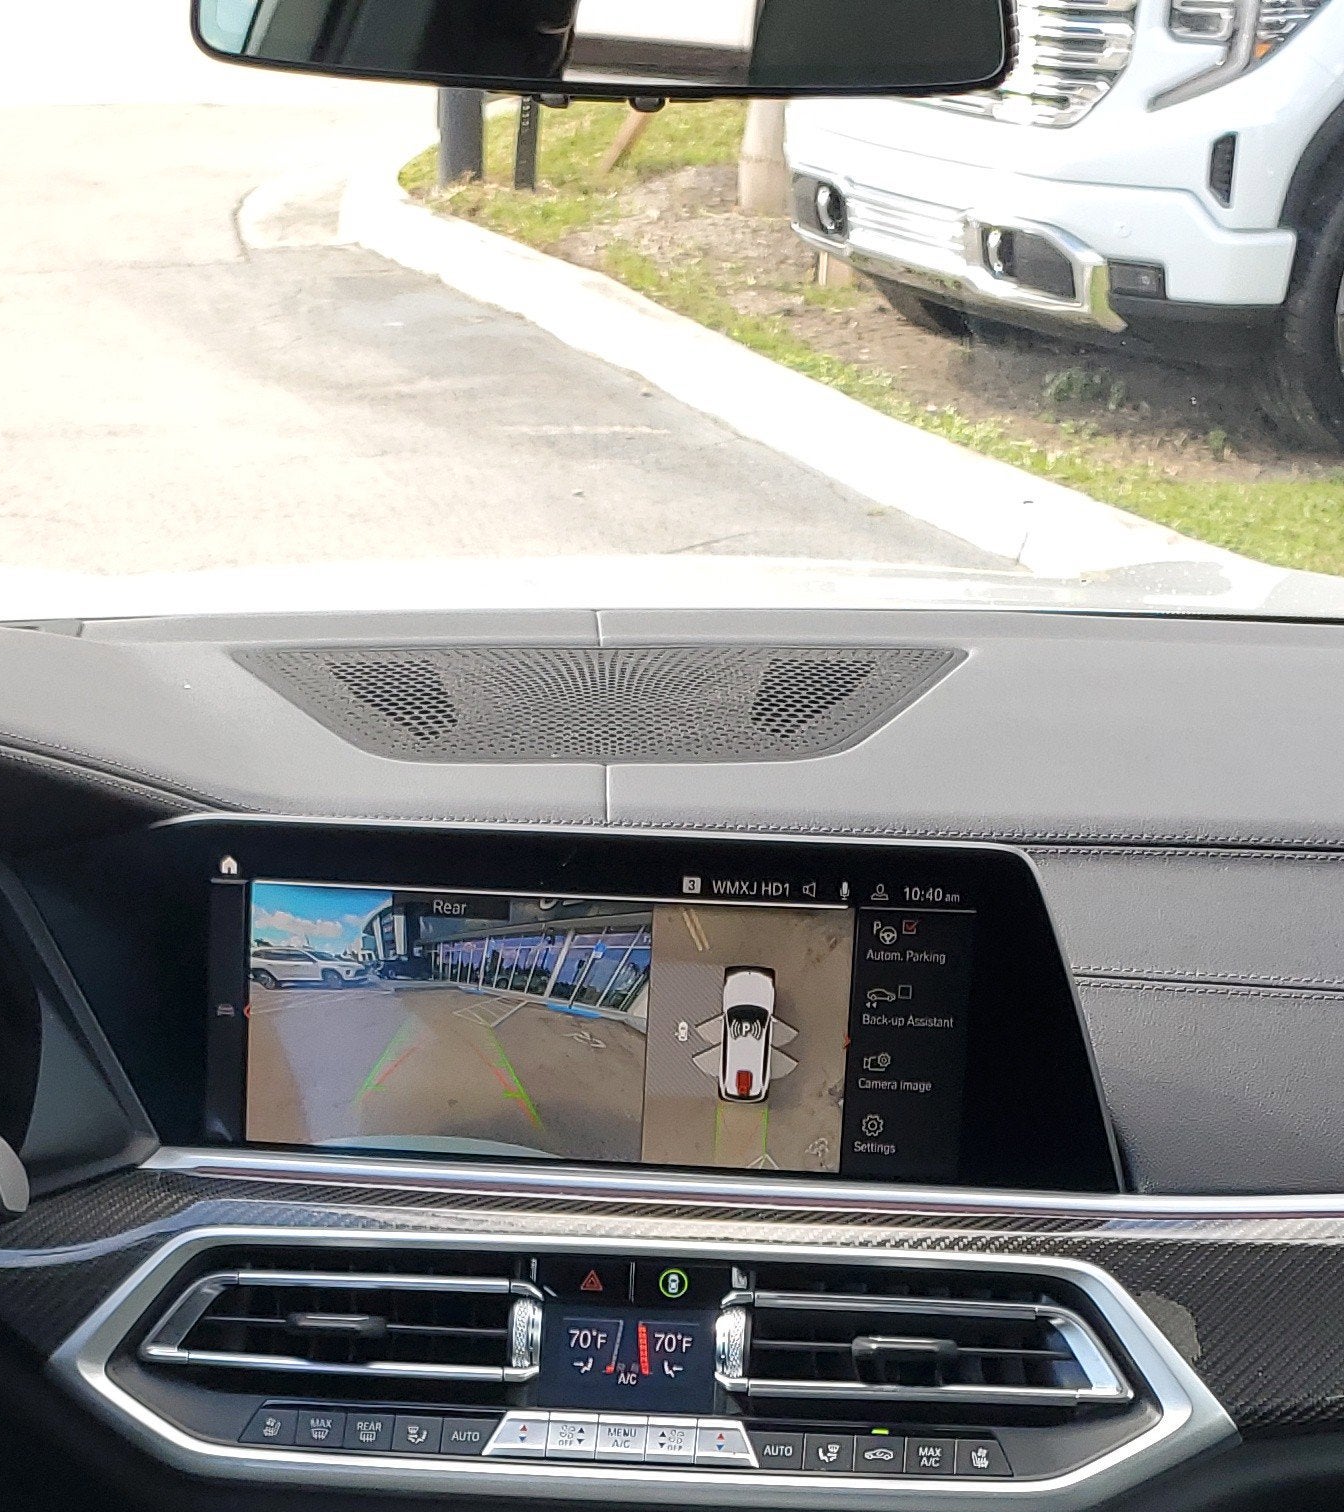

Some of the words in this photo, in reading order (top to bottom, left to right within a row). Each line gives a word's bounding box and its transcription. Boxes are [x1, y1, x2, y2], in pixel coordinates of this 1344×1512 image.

[712, 880, 757, 895] WMXJ
[761, 882, 790, 898] HD1
[903, 886, 943, 903] 10:40
[944, 893, 961, 903] am
[433, 899, 467, 915] Rear
[873, 921, 881, 935] P
[866, 949, 904, 962] Autom.
[906, 950, 947, 965] Parking
[862, 1013, 905, 1027] Back-up
[907, 1014, 954, 1029] Assistant
[742, 1022, 751, 1037] P
[858, 1077, 898, 1090] Camera
[853, 1140, 896, 1155] Settings
[568, 1328, 607, 1350] 70°F
[654, 1331, 694, 1353] 70°F
[617, 1372, 637, 1385] A/C
[310, 1418, 333, 1429] MAX
[357, 1421, 382, 1432] REAR
[450, 1430, 480, 1442] AUTO
[607, 1427, 636, 1437] MENU
[558, 1439, 573, 1447] OFF
[611, 1439, 631, 1448] A/C
[667, 1444, 682, 1452] OFF
[763, 1444, 793, 1458] AUTO
[918, 1446, 942, 1458] MAX
[920, 1458, 940, 1469] A/C
